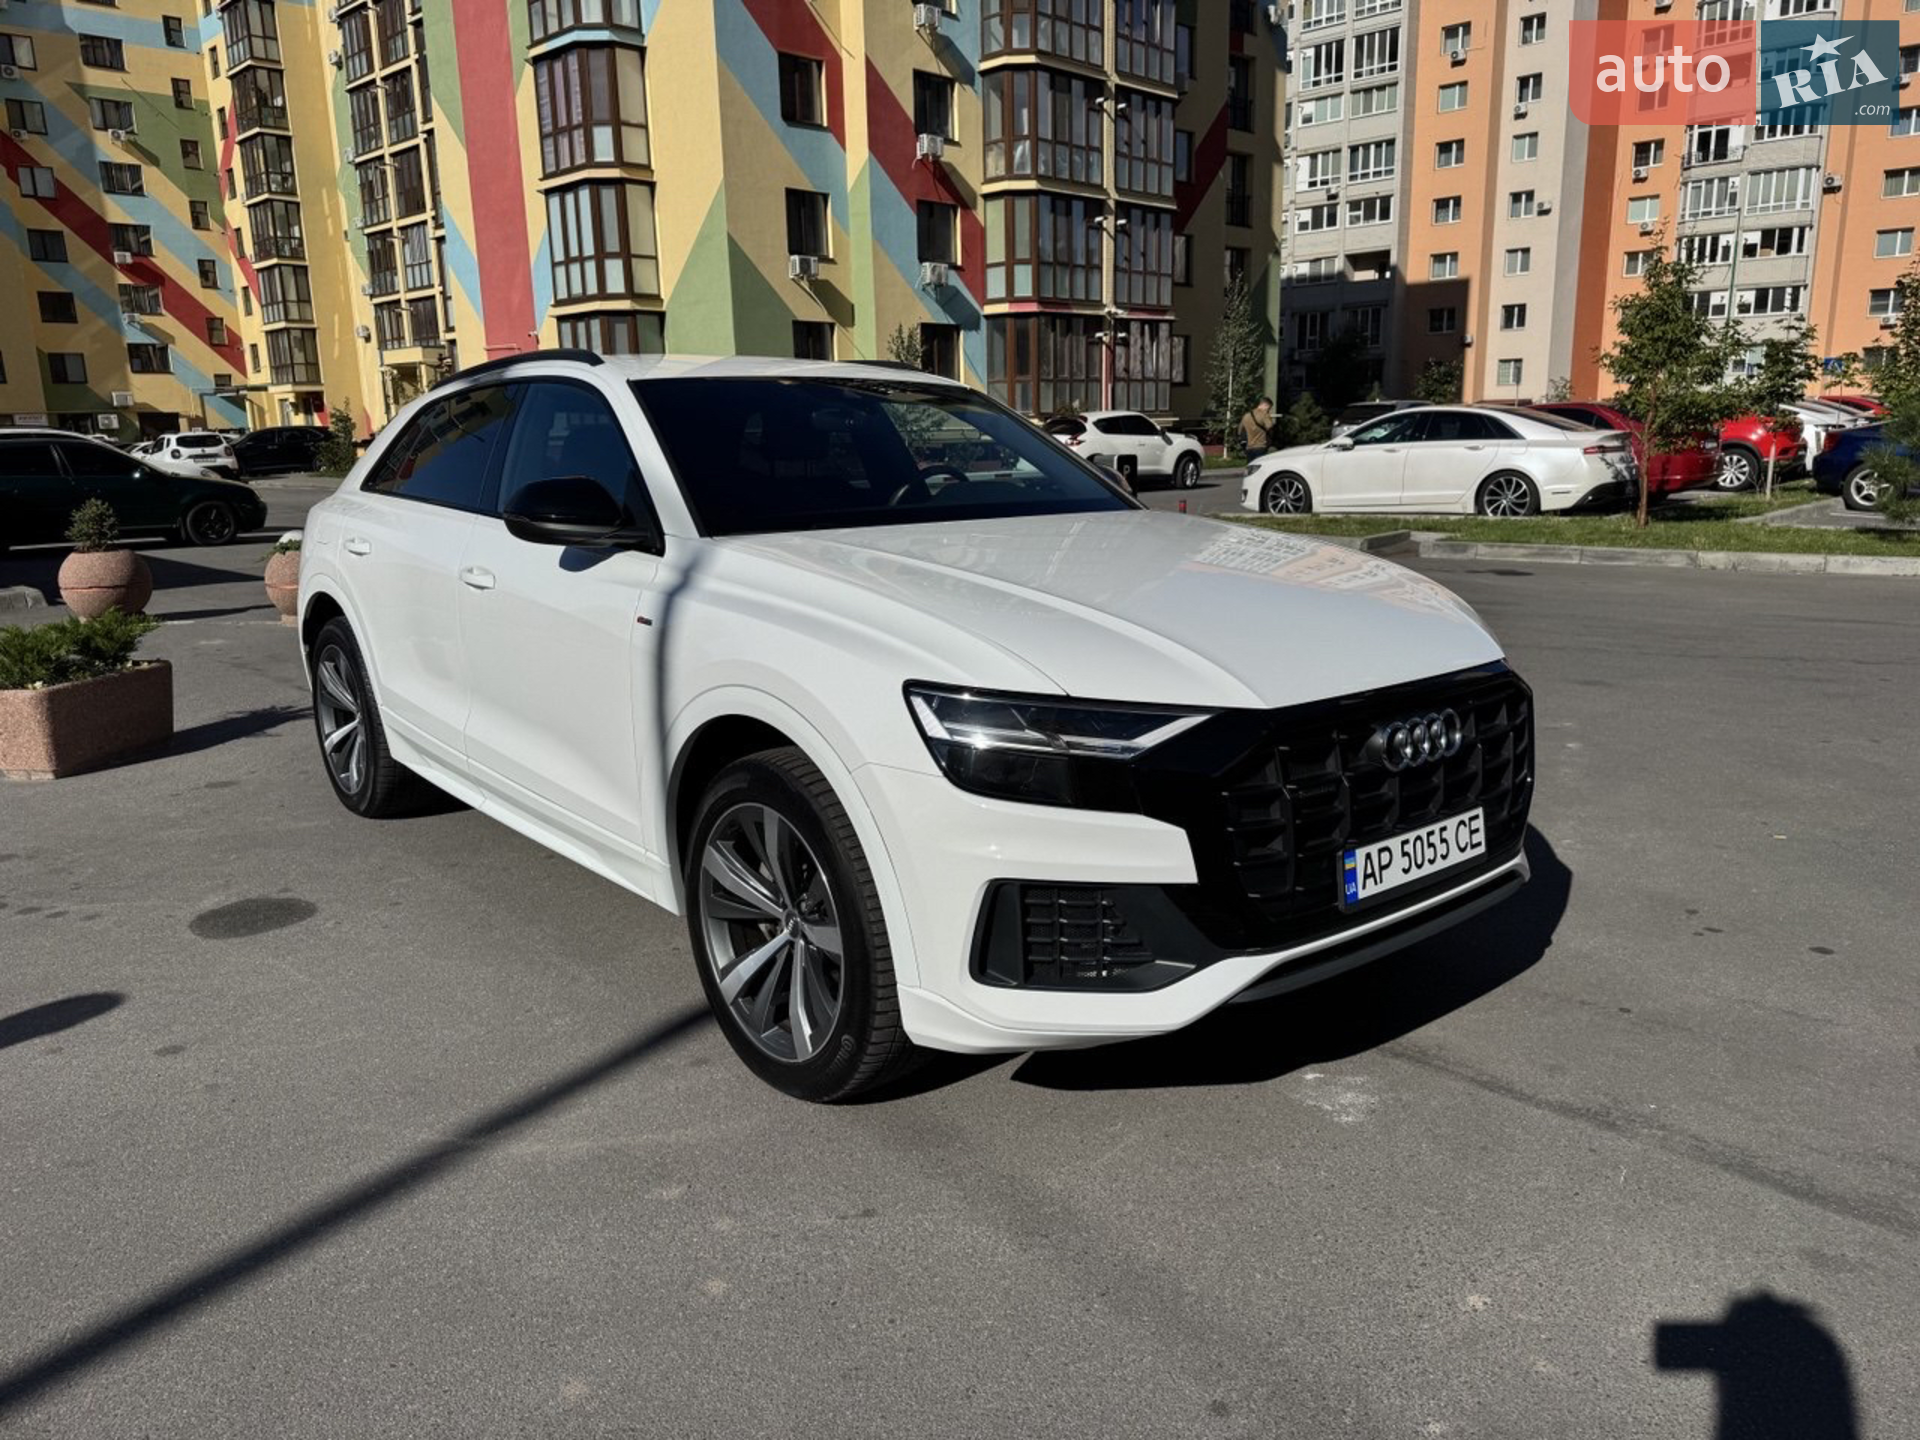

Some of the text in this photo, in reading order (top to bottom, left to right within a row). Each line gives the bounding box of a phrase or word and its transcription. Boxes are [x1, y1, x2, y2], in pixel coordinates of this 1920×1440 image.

[1361, 813, 1483, 890] AP 5055 CE
